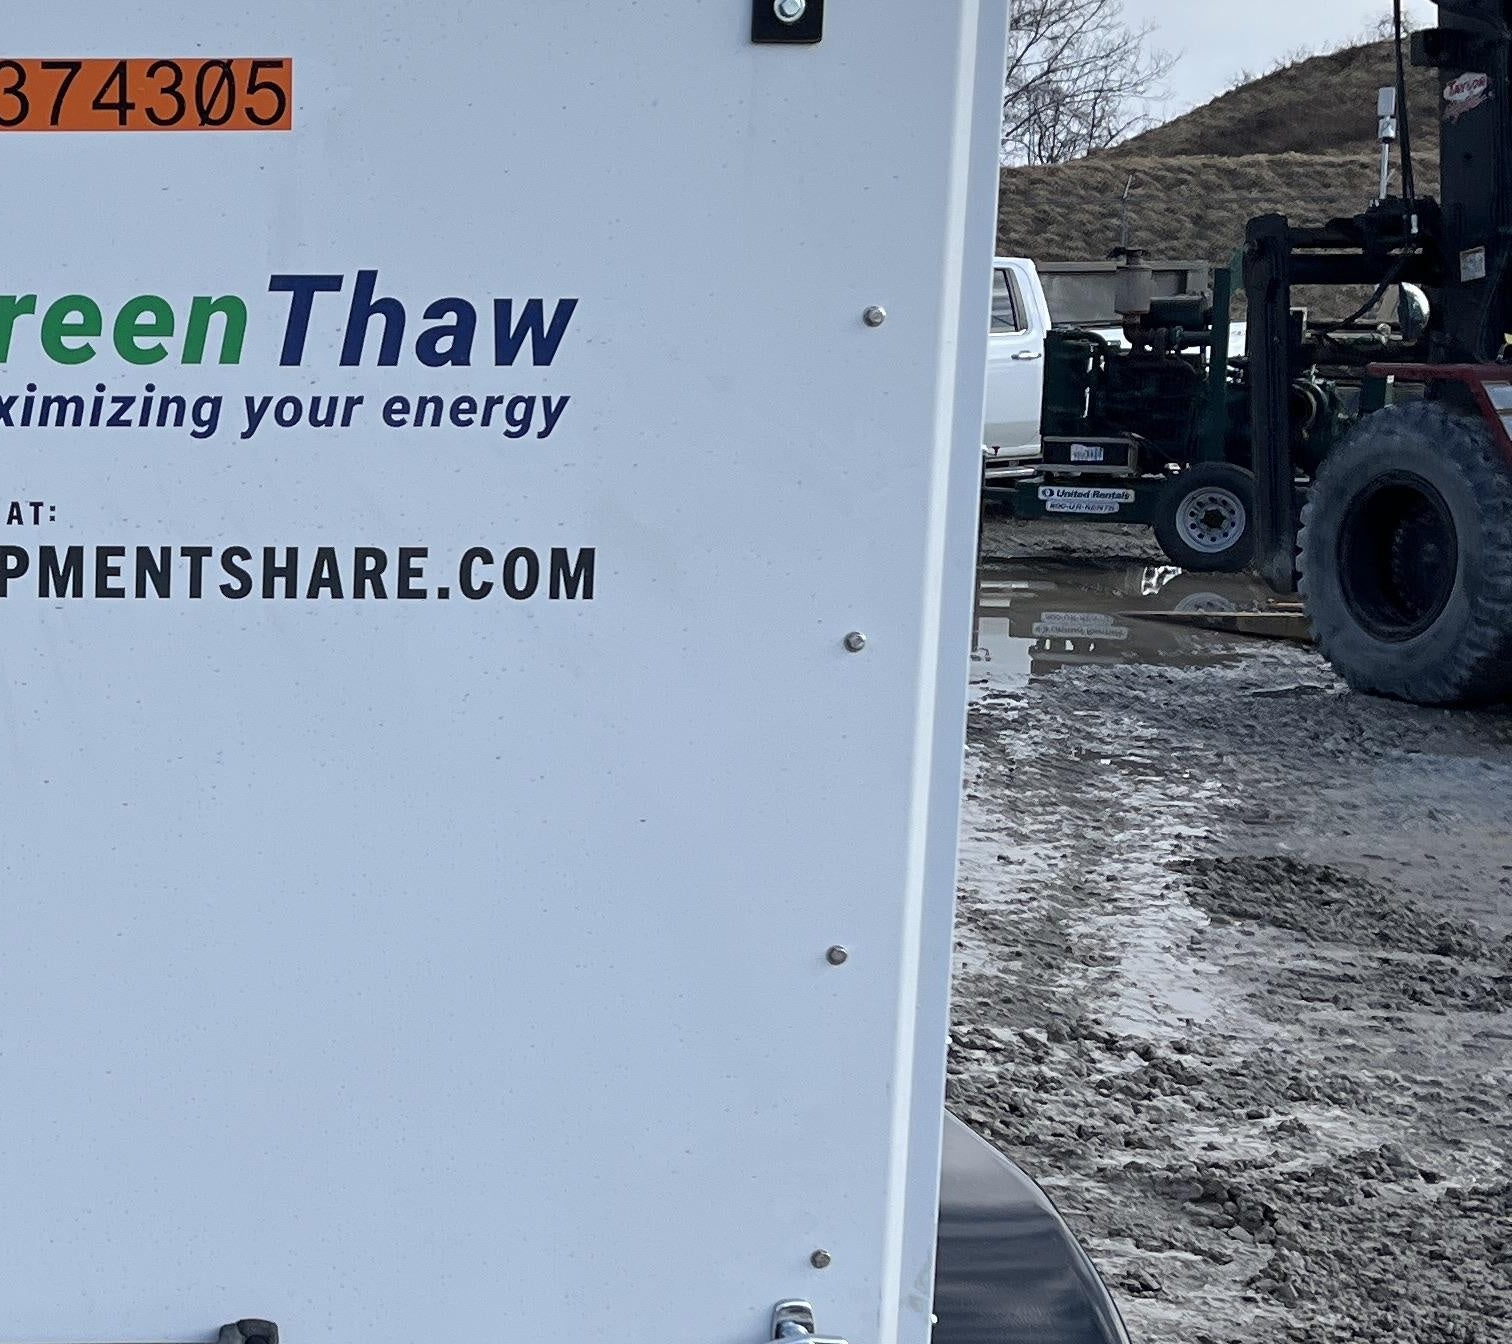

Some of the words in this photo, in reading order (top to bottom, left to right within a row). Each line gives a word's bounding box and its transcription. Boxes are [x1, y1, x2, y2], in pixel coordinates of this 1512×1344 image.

[240, 395, 365, 440] your
[382, 395, 571, 440] energy
[6, 501, 57, 526] AT:
